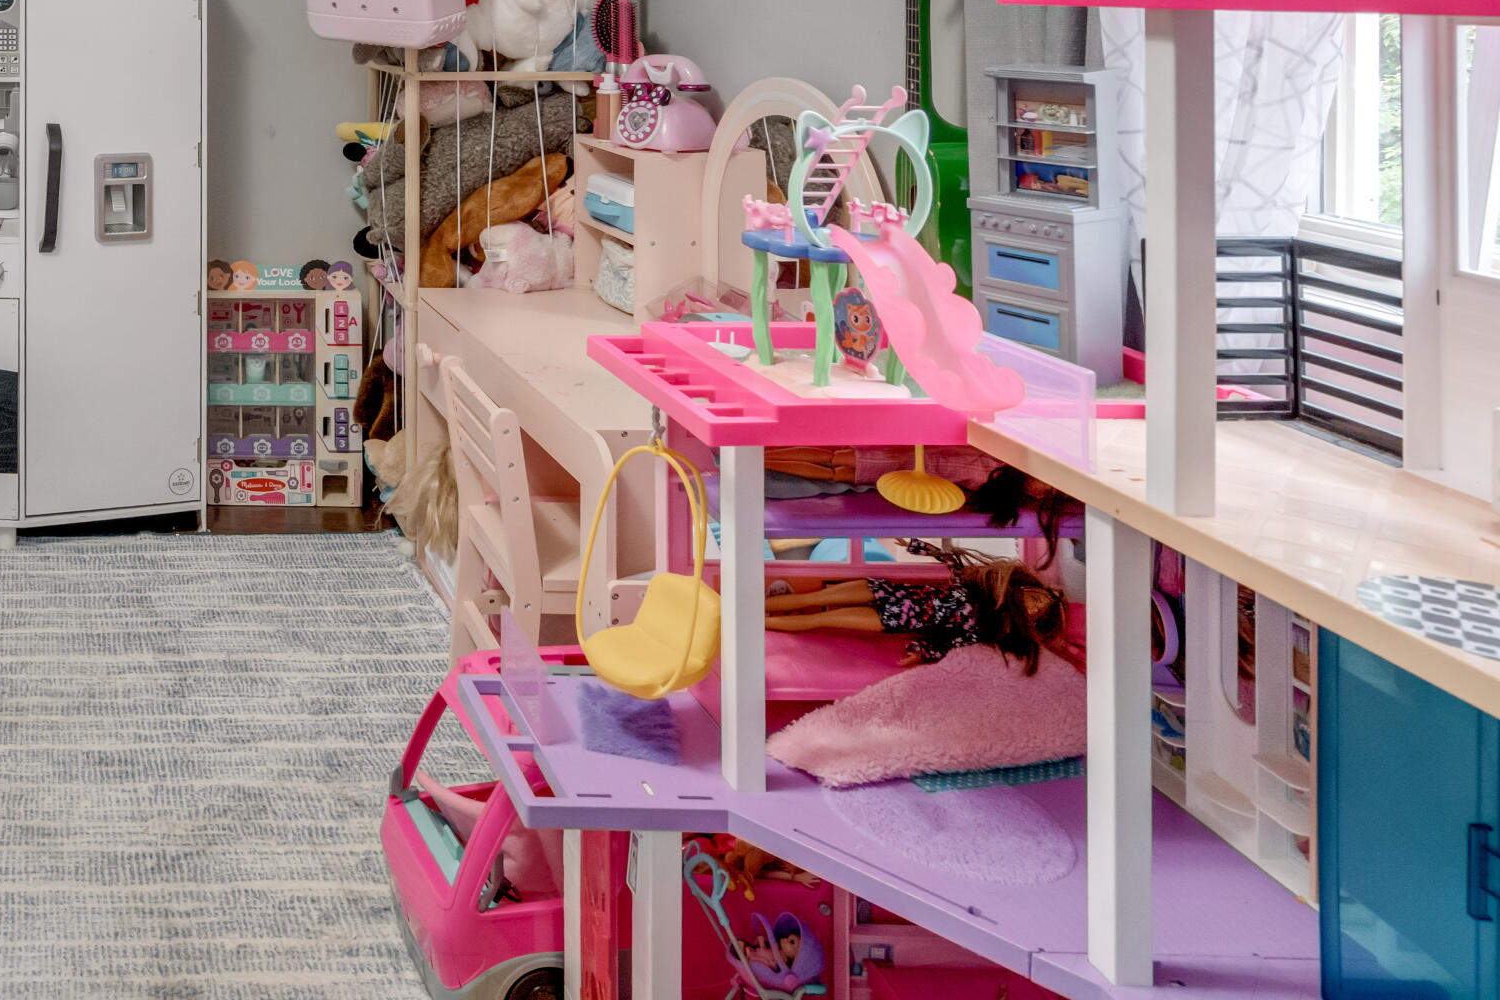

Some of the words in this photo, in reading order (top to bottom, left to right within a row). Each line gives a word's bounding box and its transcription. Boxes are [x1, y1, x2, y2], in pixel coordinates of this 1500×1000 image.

[264, 268, 293, 278] LOVE
[257, 278, 276, 286] Your
[278, 278, 302, 286] Look
[338, 306, 344, 314] 1
[338, 319, 345, 328] 2
[348, 316, 358, 327] A
[338, 332, 345, 341] 3
[349, 369, 358, 380] B
[339, 411, 345, 421] 1
[339, 426, 346, 435] 2
[350, 423, 359, 433] C
[339, 439, 345, 448] 3
